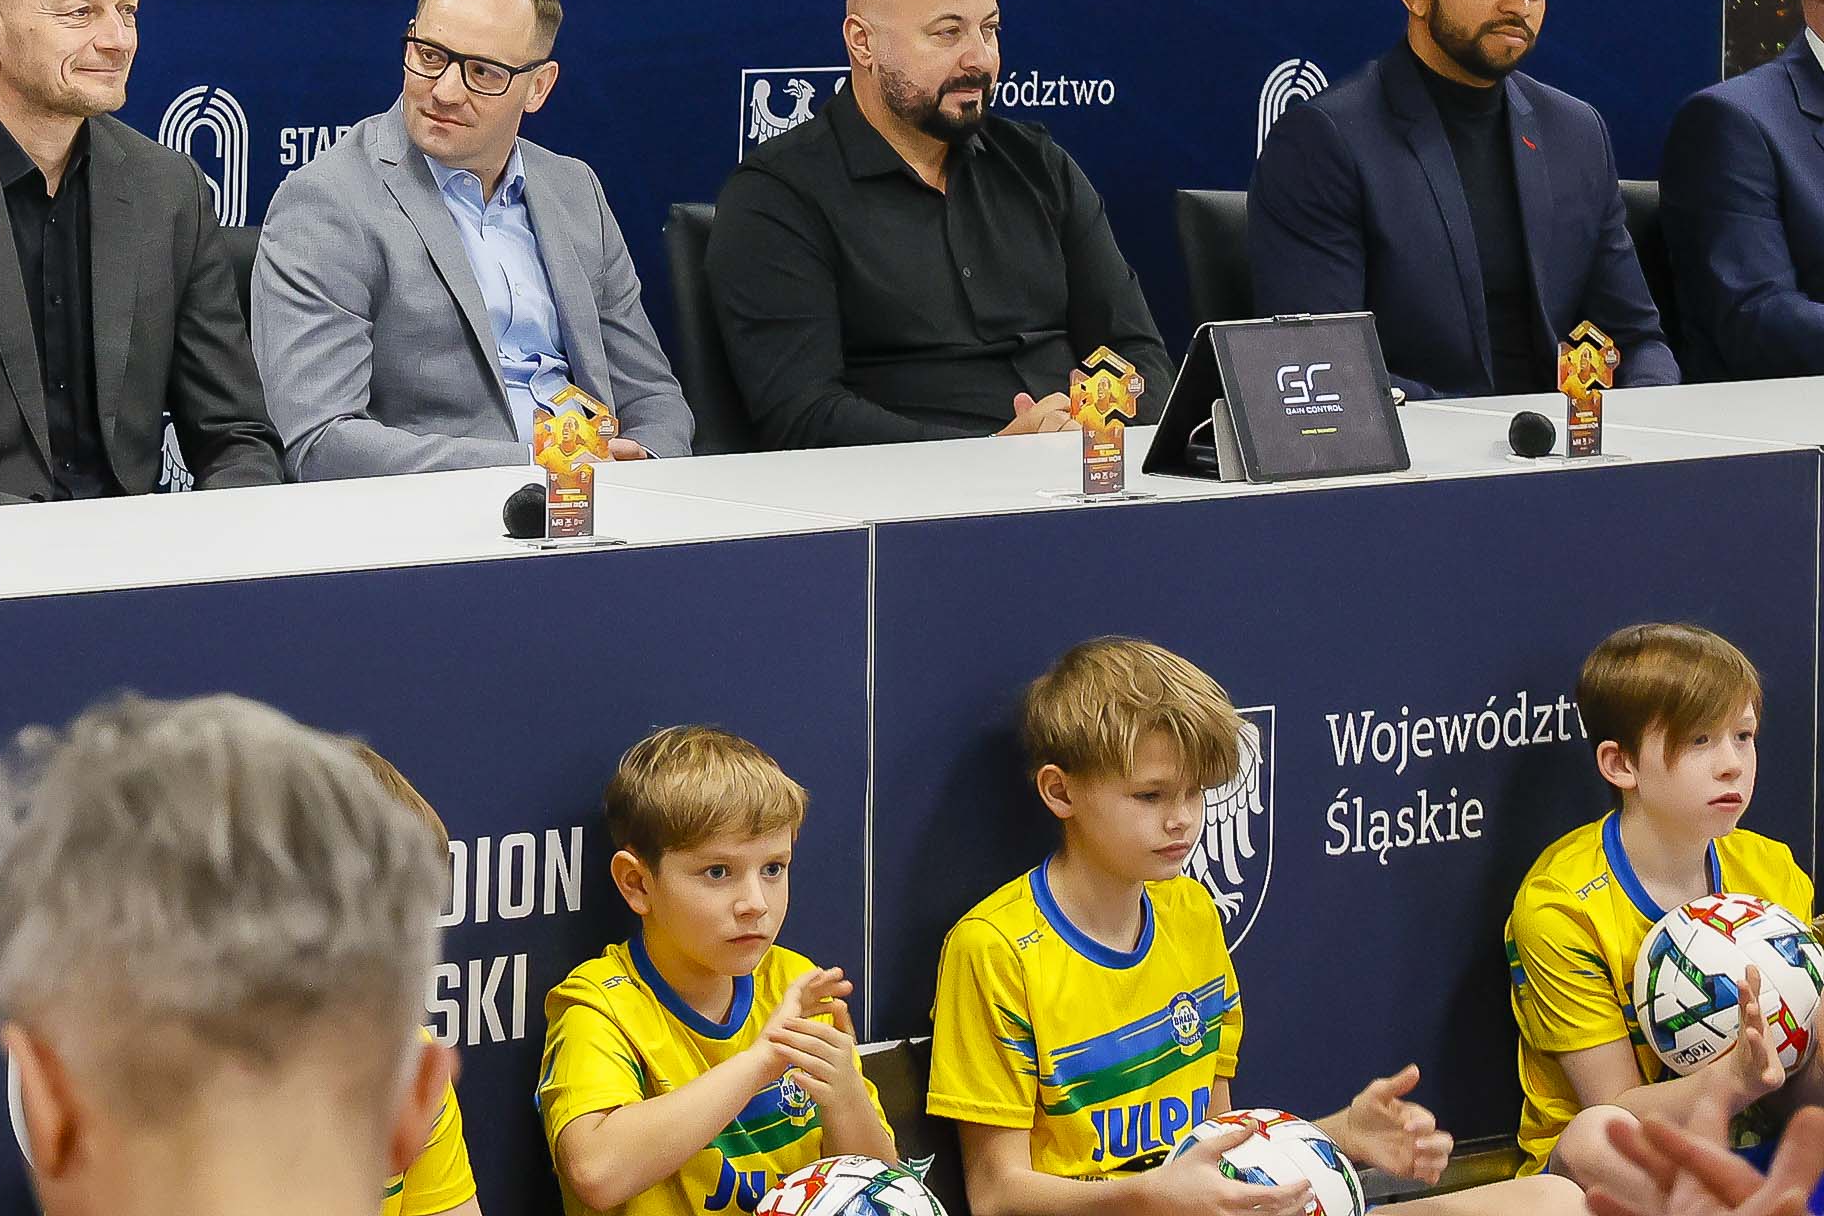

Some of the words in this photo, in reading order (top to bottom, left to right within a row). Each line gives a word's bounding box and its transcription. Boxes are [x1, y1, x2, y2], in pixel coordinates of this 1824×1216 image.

[990, 70, 1115, 107] ództwo
[1306, 404, 1344, 414] CONTROL
[1325, 787, 1484, 866] Śląskie
